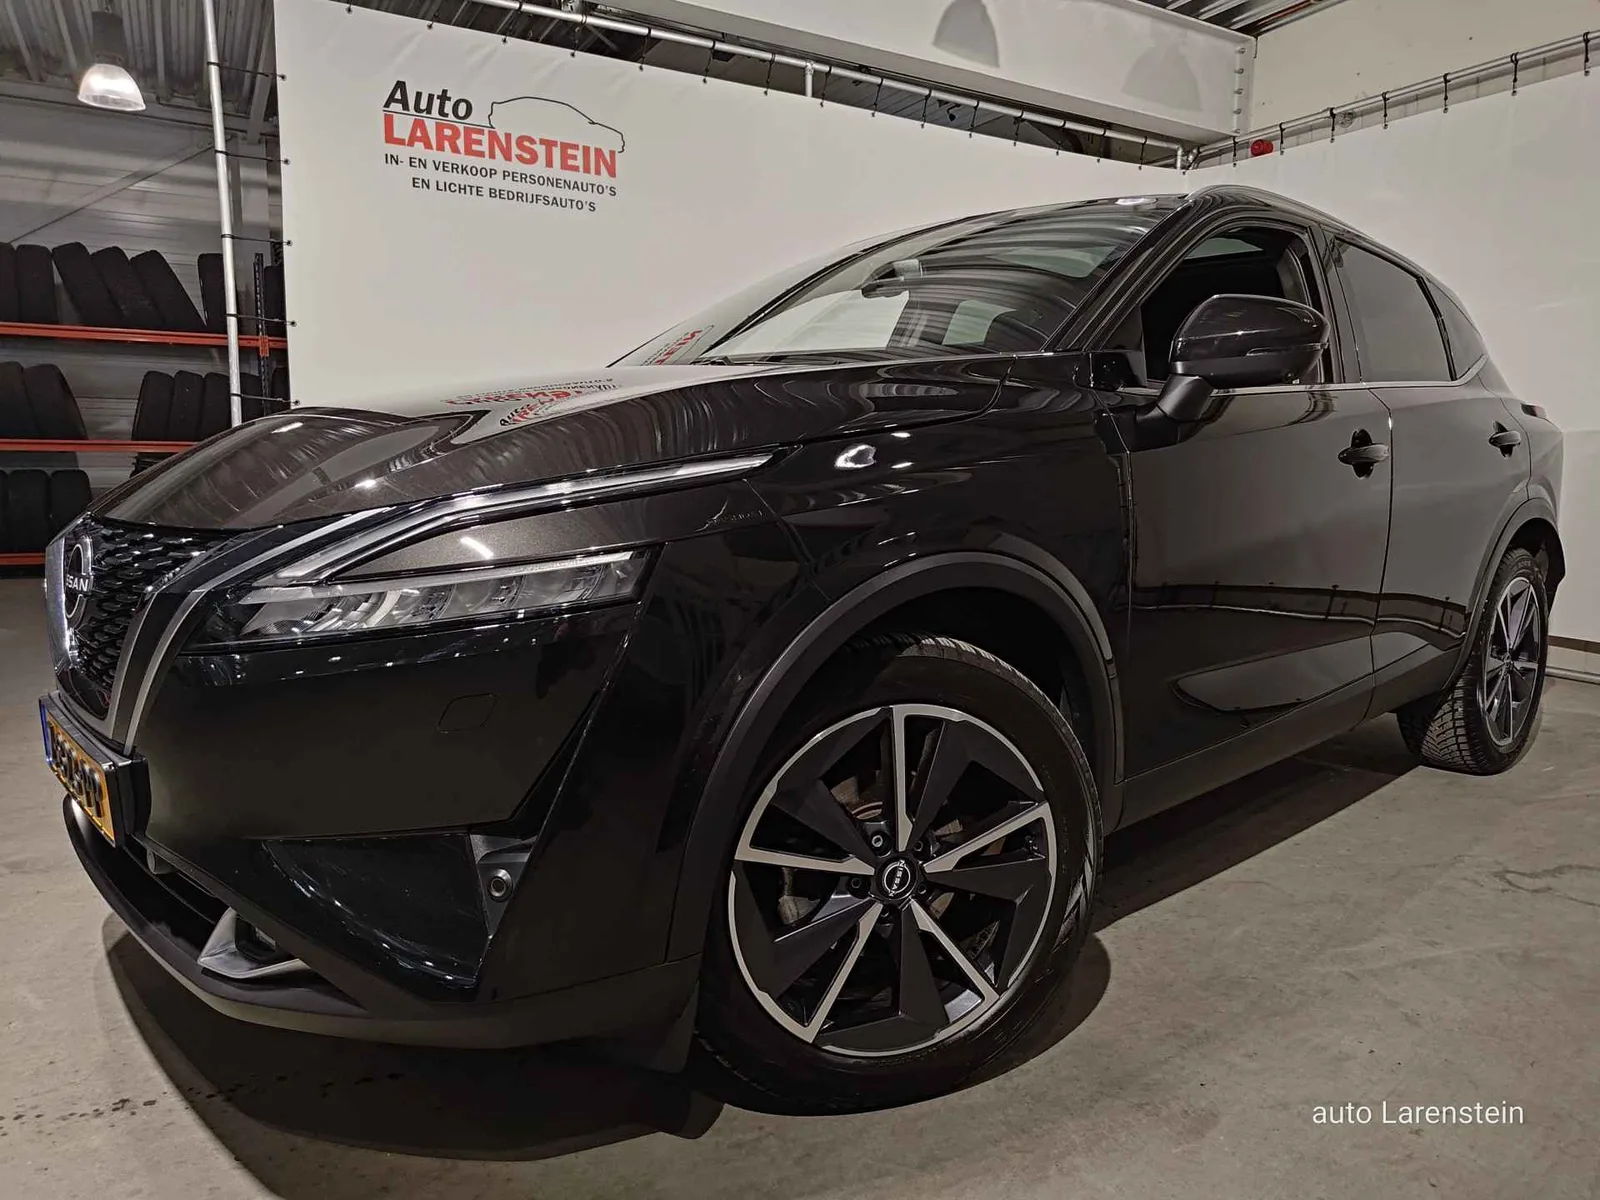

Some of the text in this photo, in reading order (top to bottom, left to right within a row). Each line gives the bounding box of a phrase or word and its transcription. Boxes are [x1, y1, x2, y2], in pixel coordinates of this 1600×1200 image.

[383, 80, 473, 121] Auto
[383, 112, 617, 178] LARENSTEIN
[384, 153, 617, 197] IN- EN VERKOOP PERSONENAUTO'S
[412, 177, 597, 213] EN LICHTE BEDRIJFSAUTO'S
